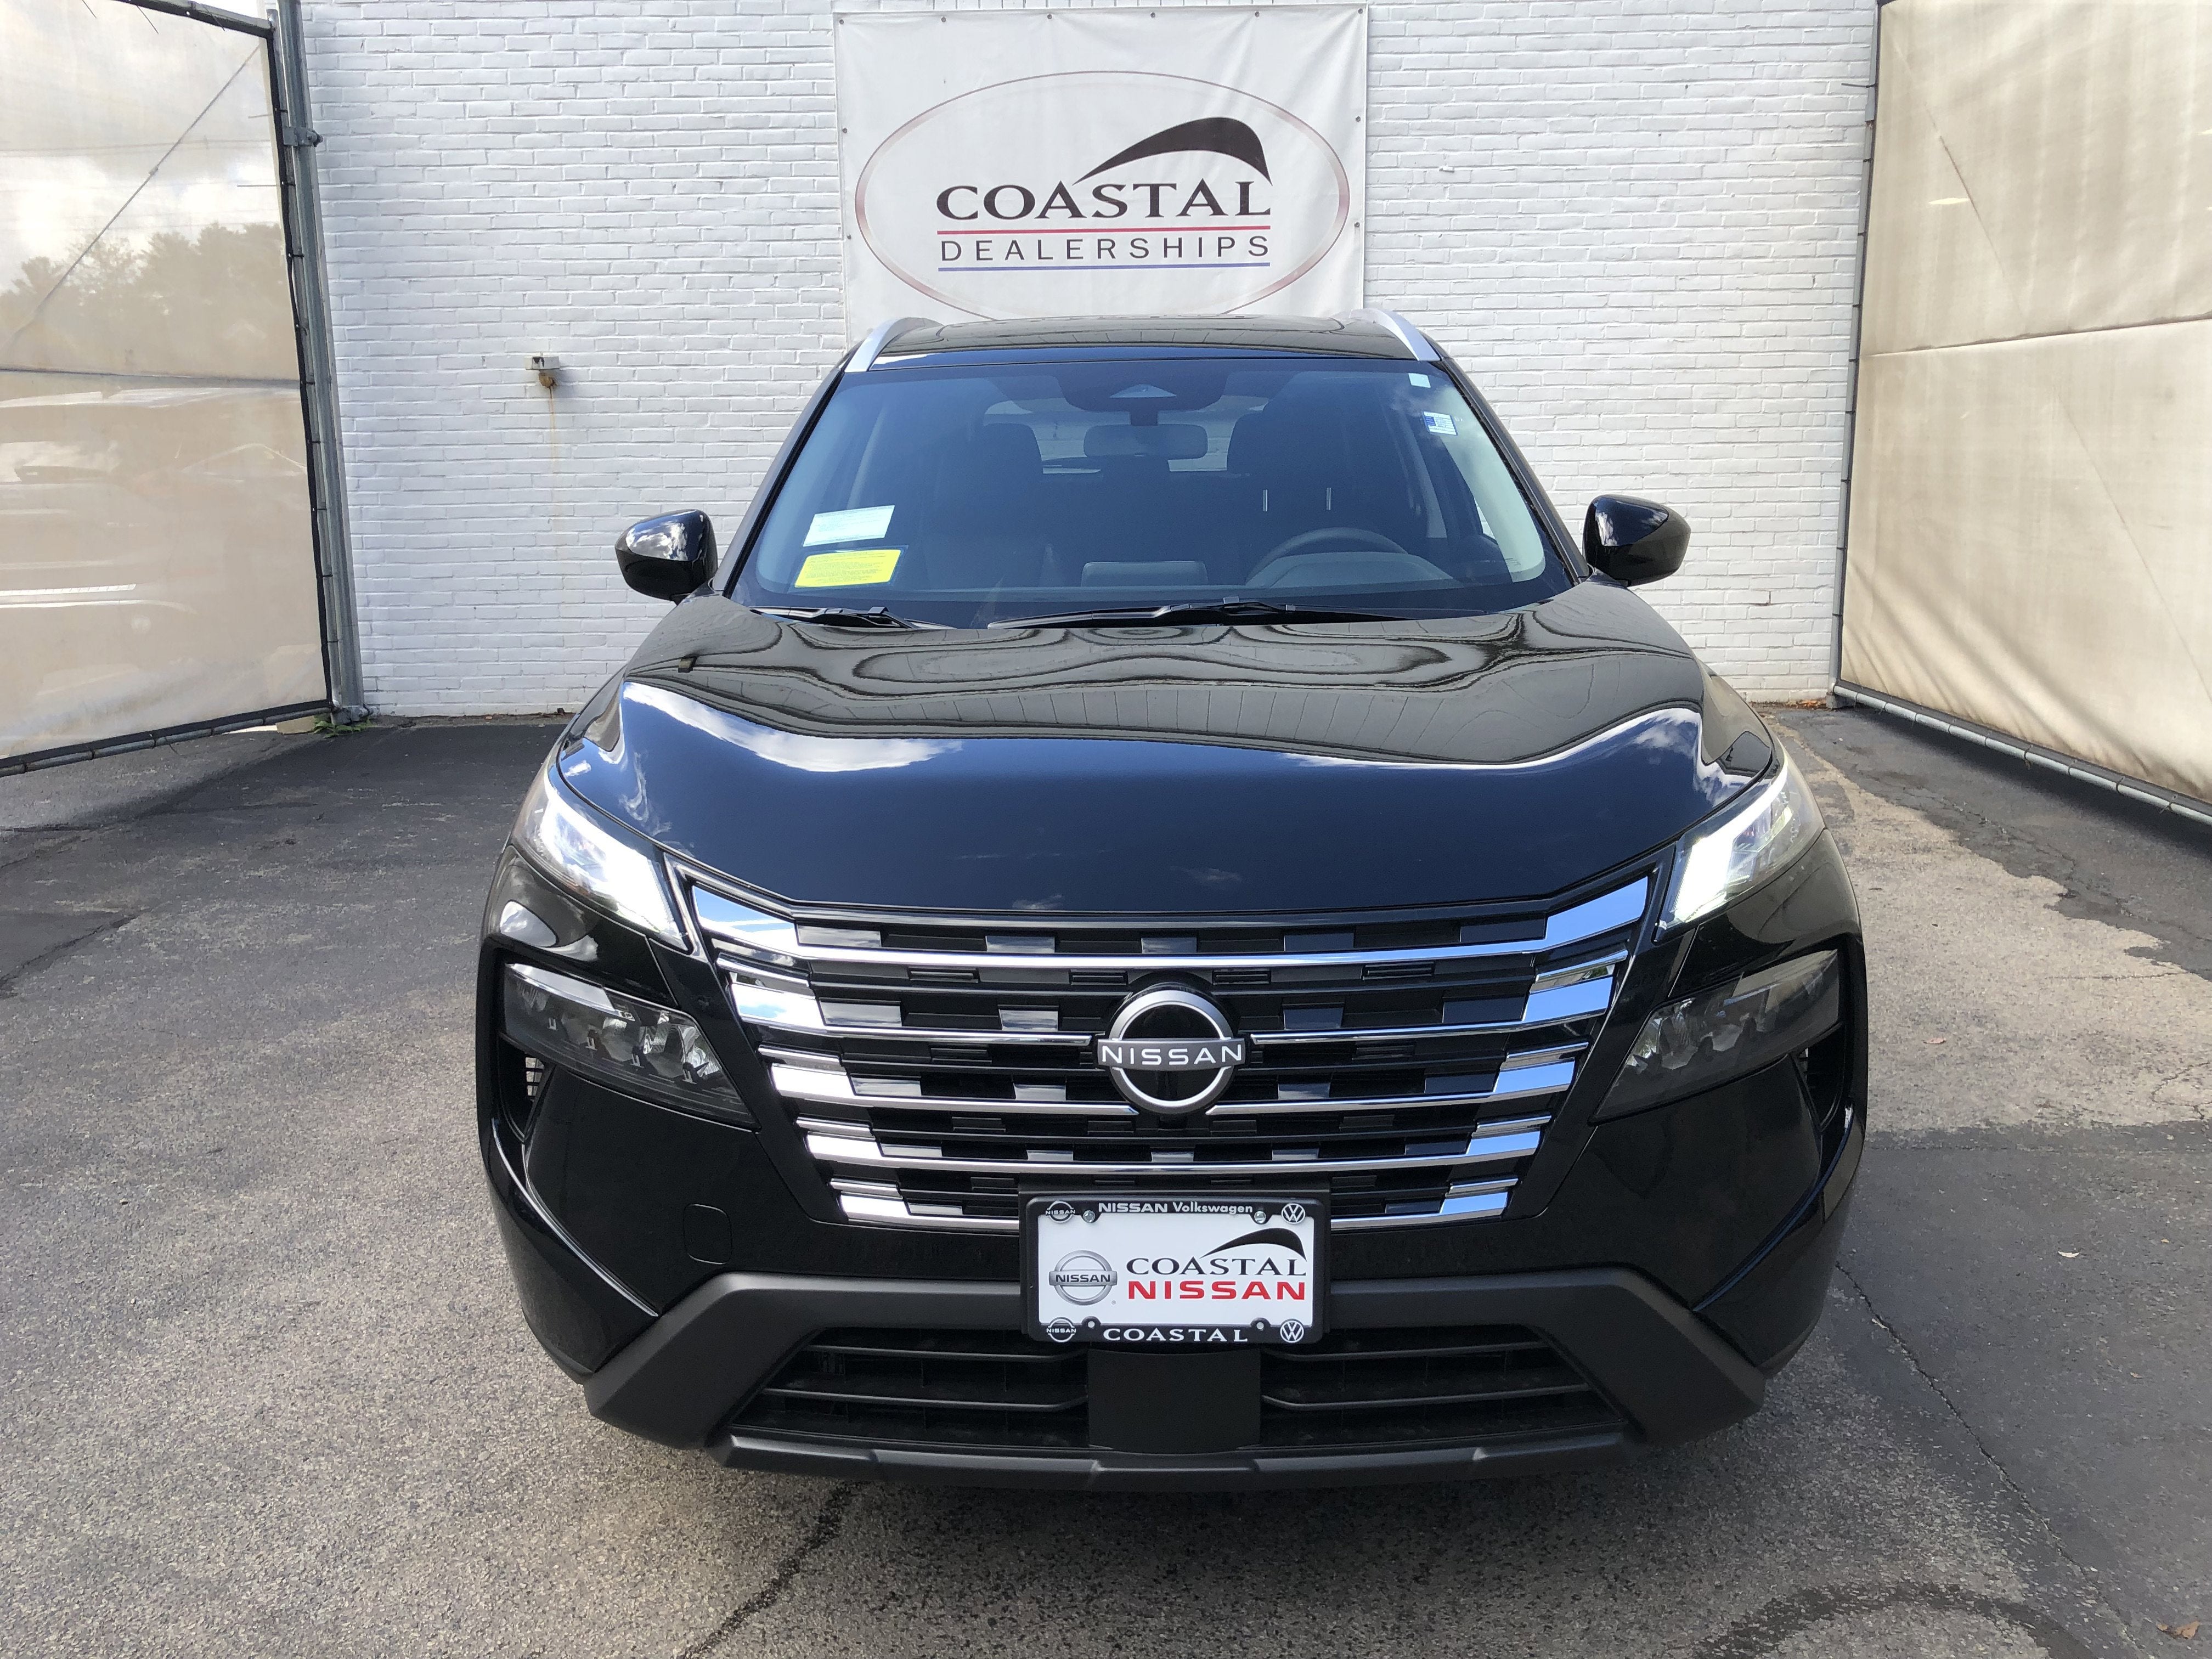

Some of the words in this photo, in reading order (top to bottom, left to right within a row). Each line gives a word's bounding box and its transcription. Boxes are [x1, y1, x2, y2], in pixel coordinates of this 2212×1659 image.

[936, 178, 1271, 219] COASTAL
[941, 235, 1269, 262] DEALERSHIPS
[1102, 1045, 1242, 1065] NISSAN
[1098, 1202, 1167, 1212] NISSAN
[1173, 1201, 1252, 1215] Volkswagen
[1126, 1256, 1307, 1276] COASTAL
[1056, 1274, 1110, 1283] NISSAN
[1128, 1281, 1305, 1300] NISSAN
[1103, 1328, 1248, 1342] COASTAL
